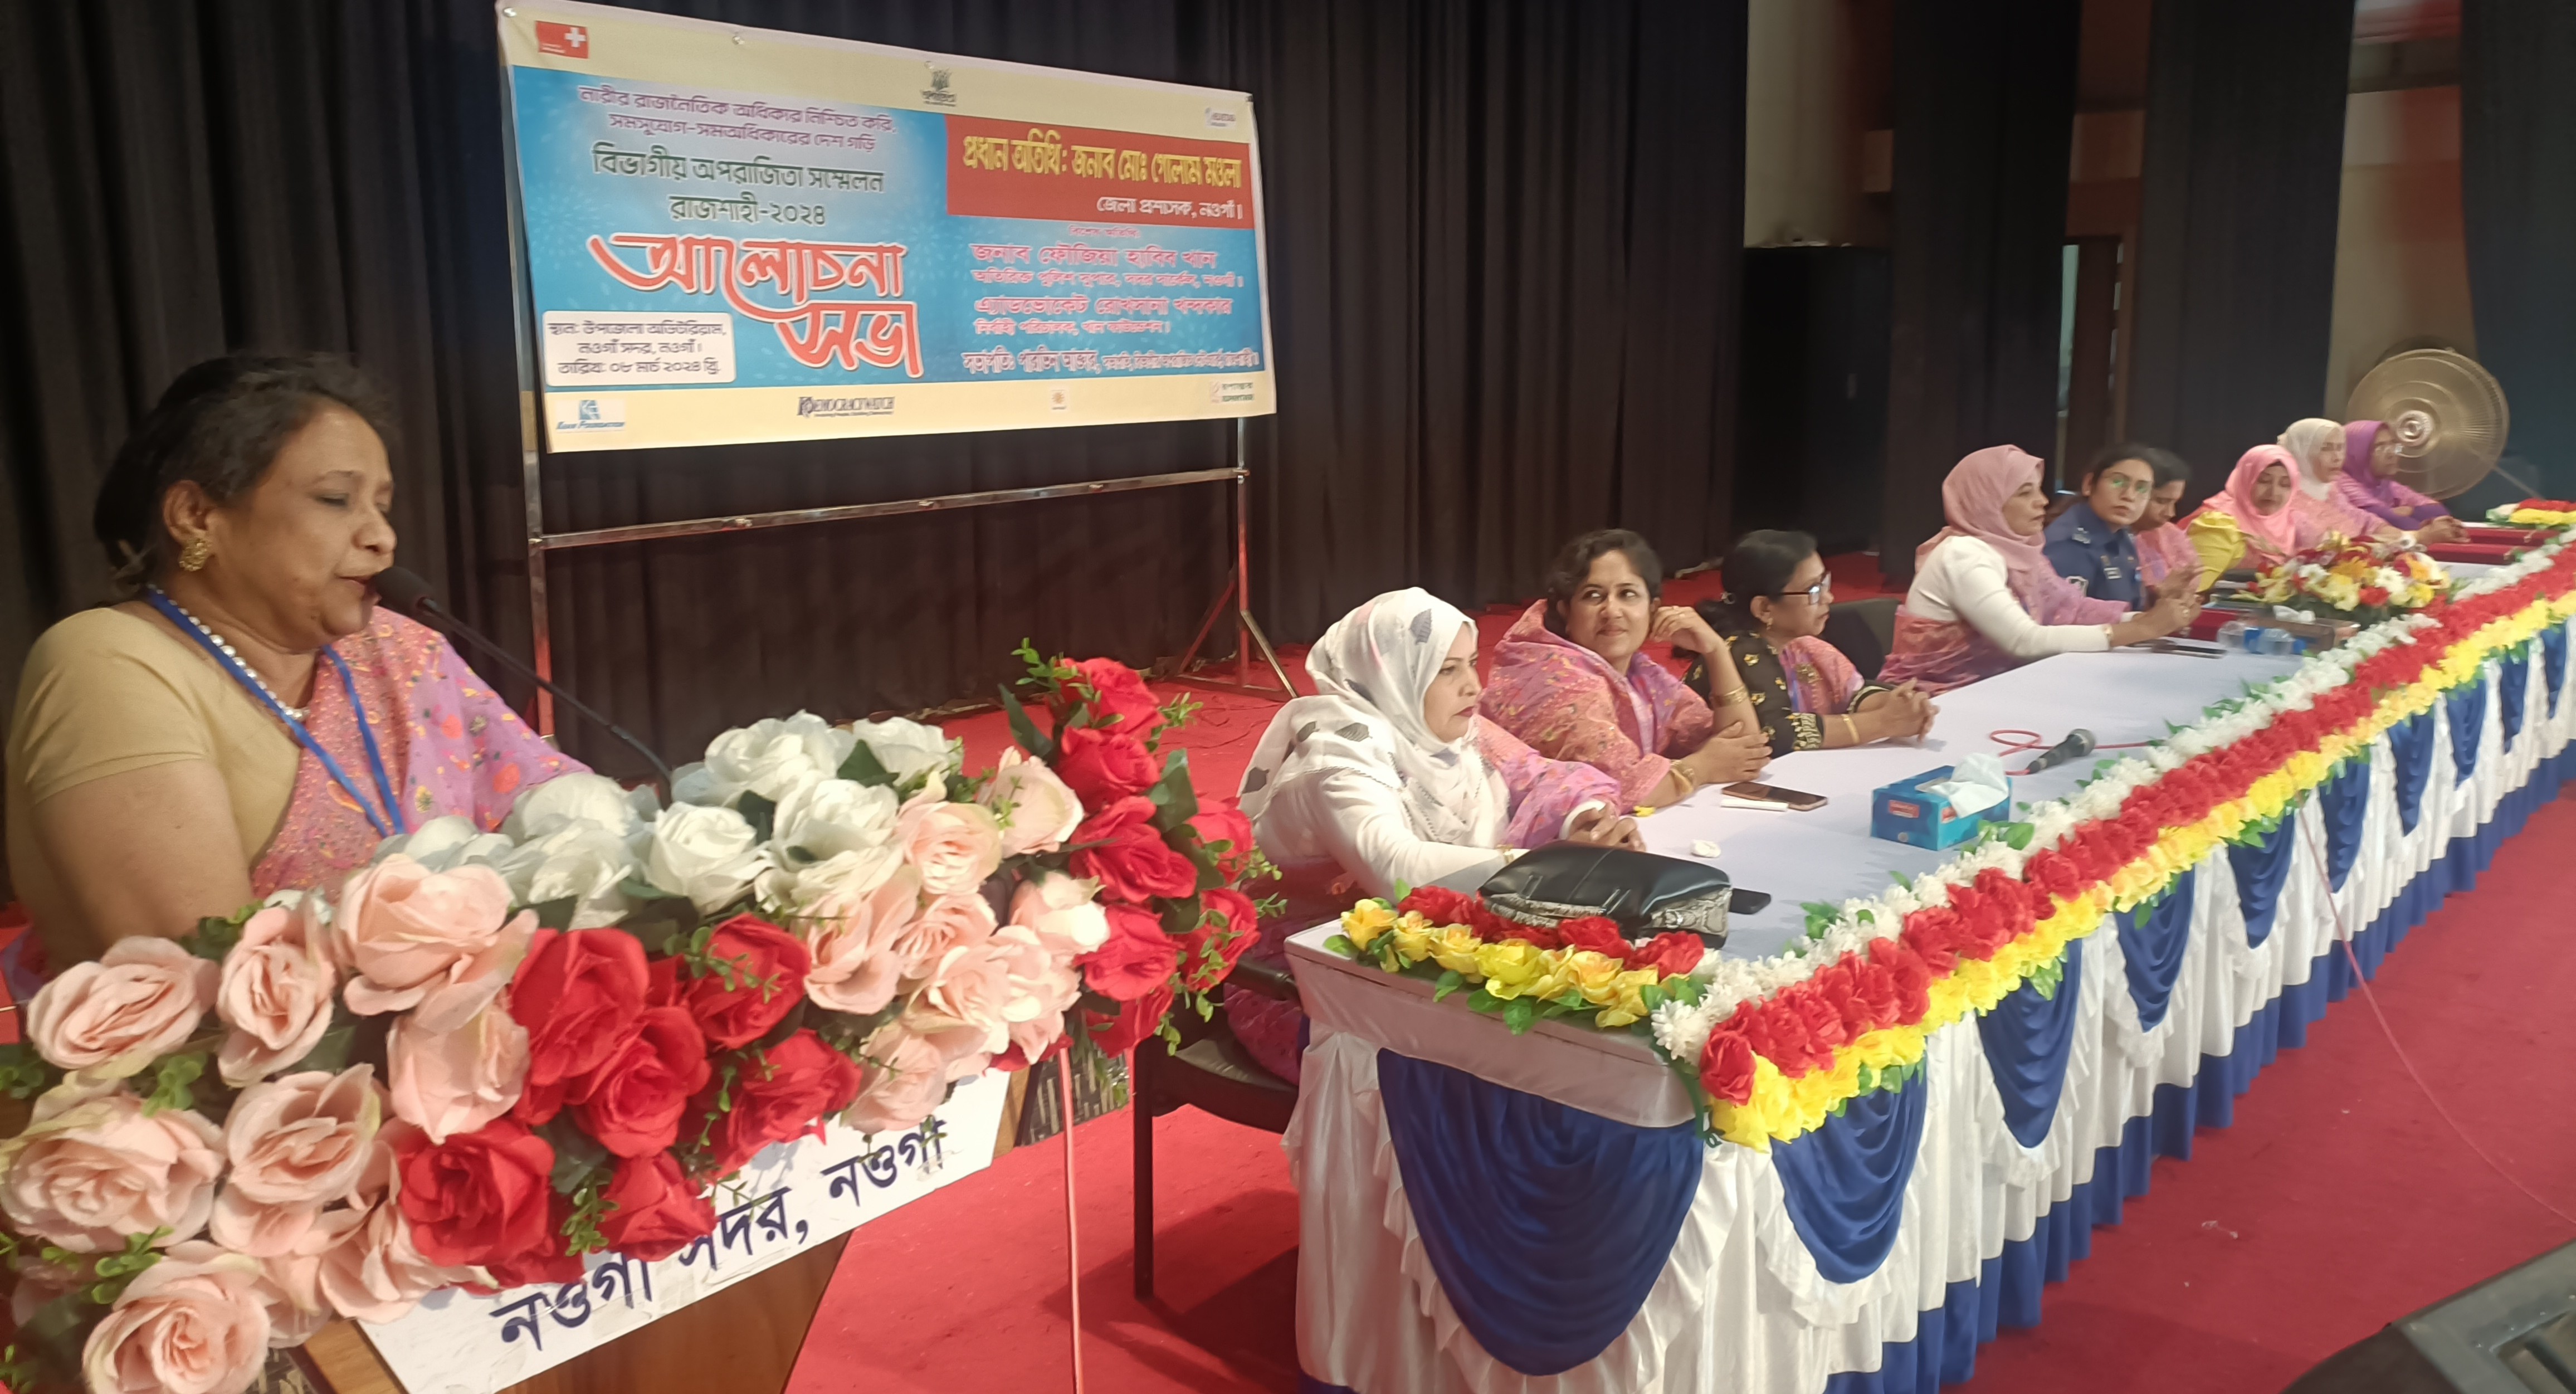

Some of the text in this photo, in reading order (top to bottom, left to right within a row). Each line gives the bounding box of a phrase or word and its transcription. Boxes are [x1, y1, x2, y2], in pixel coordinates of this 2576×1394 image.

[578, 85, 630, 105] নারীর
[633, 95, 728, 114] রাজনৈতিক
[733, 101, 802, 123] অধিকার
[805, 106, 859, 128] নিশ্চিত
[813, 134, 845, 148] দেশ
[847, 134, 876, 153] গড়ি
[592, 142, 885, 192] বিভাগীয় অপরাজিতা সম্মেলন
[963, 136, 1009, 171] প্রধান
[1071, 145, 1116, 179] জনাব
[1151, 153, 1203, 185] গোলাম
[1096, 196, 1138, 213] জেলা
[588, 233, 908, 304] আলোচনা
[969, 243, 1032, 264] জনাব
[1124, 244, 1178, 269] হাবিব
[1181, 249, 1218, 269] খান
[582, 320, 645, 334] উপজেলা
[777, 301, 924, 378] সভা
[577, 338, 619, 354] নওগাঁ
[635, 357, 661, 373] মার্চ
